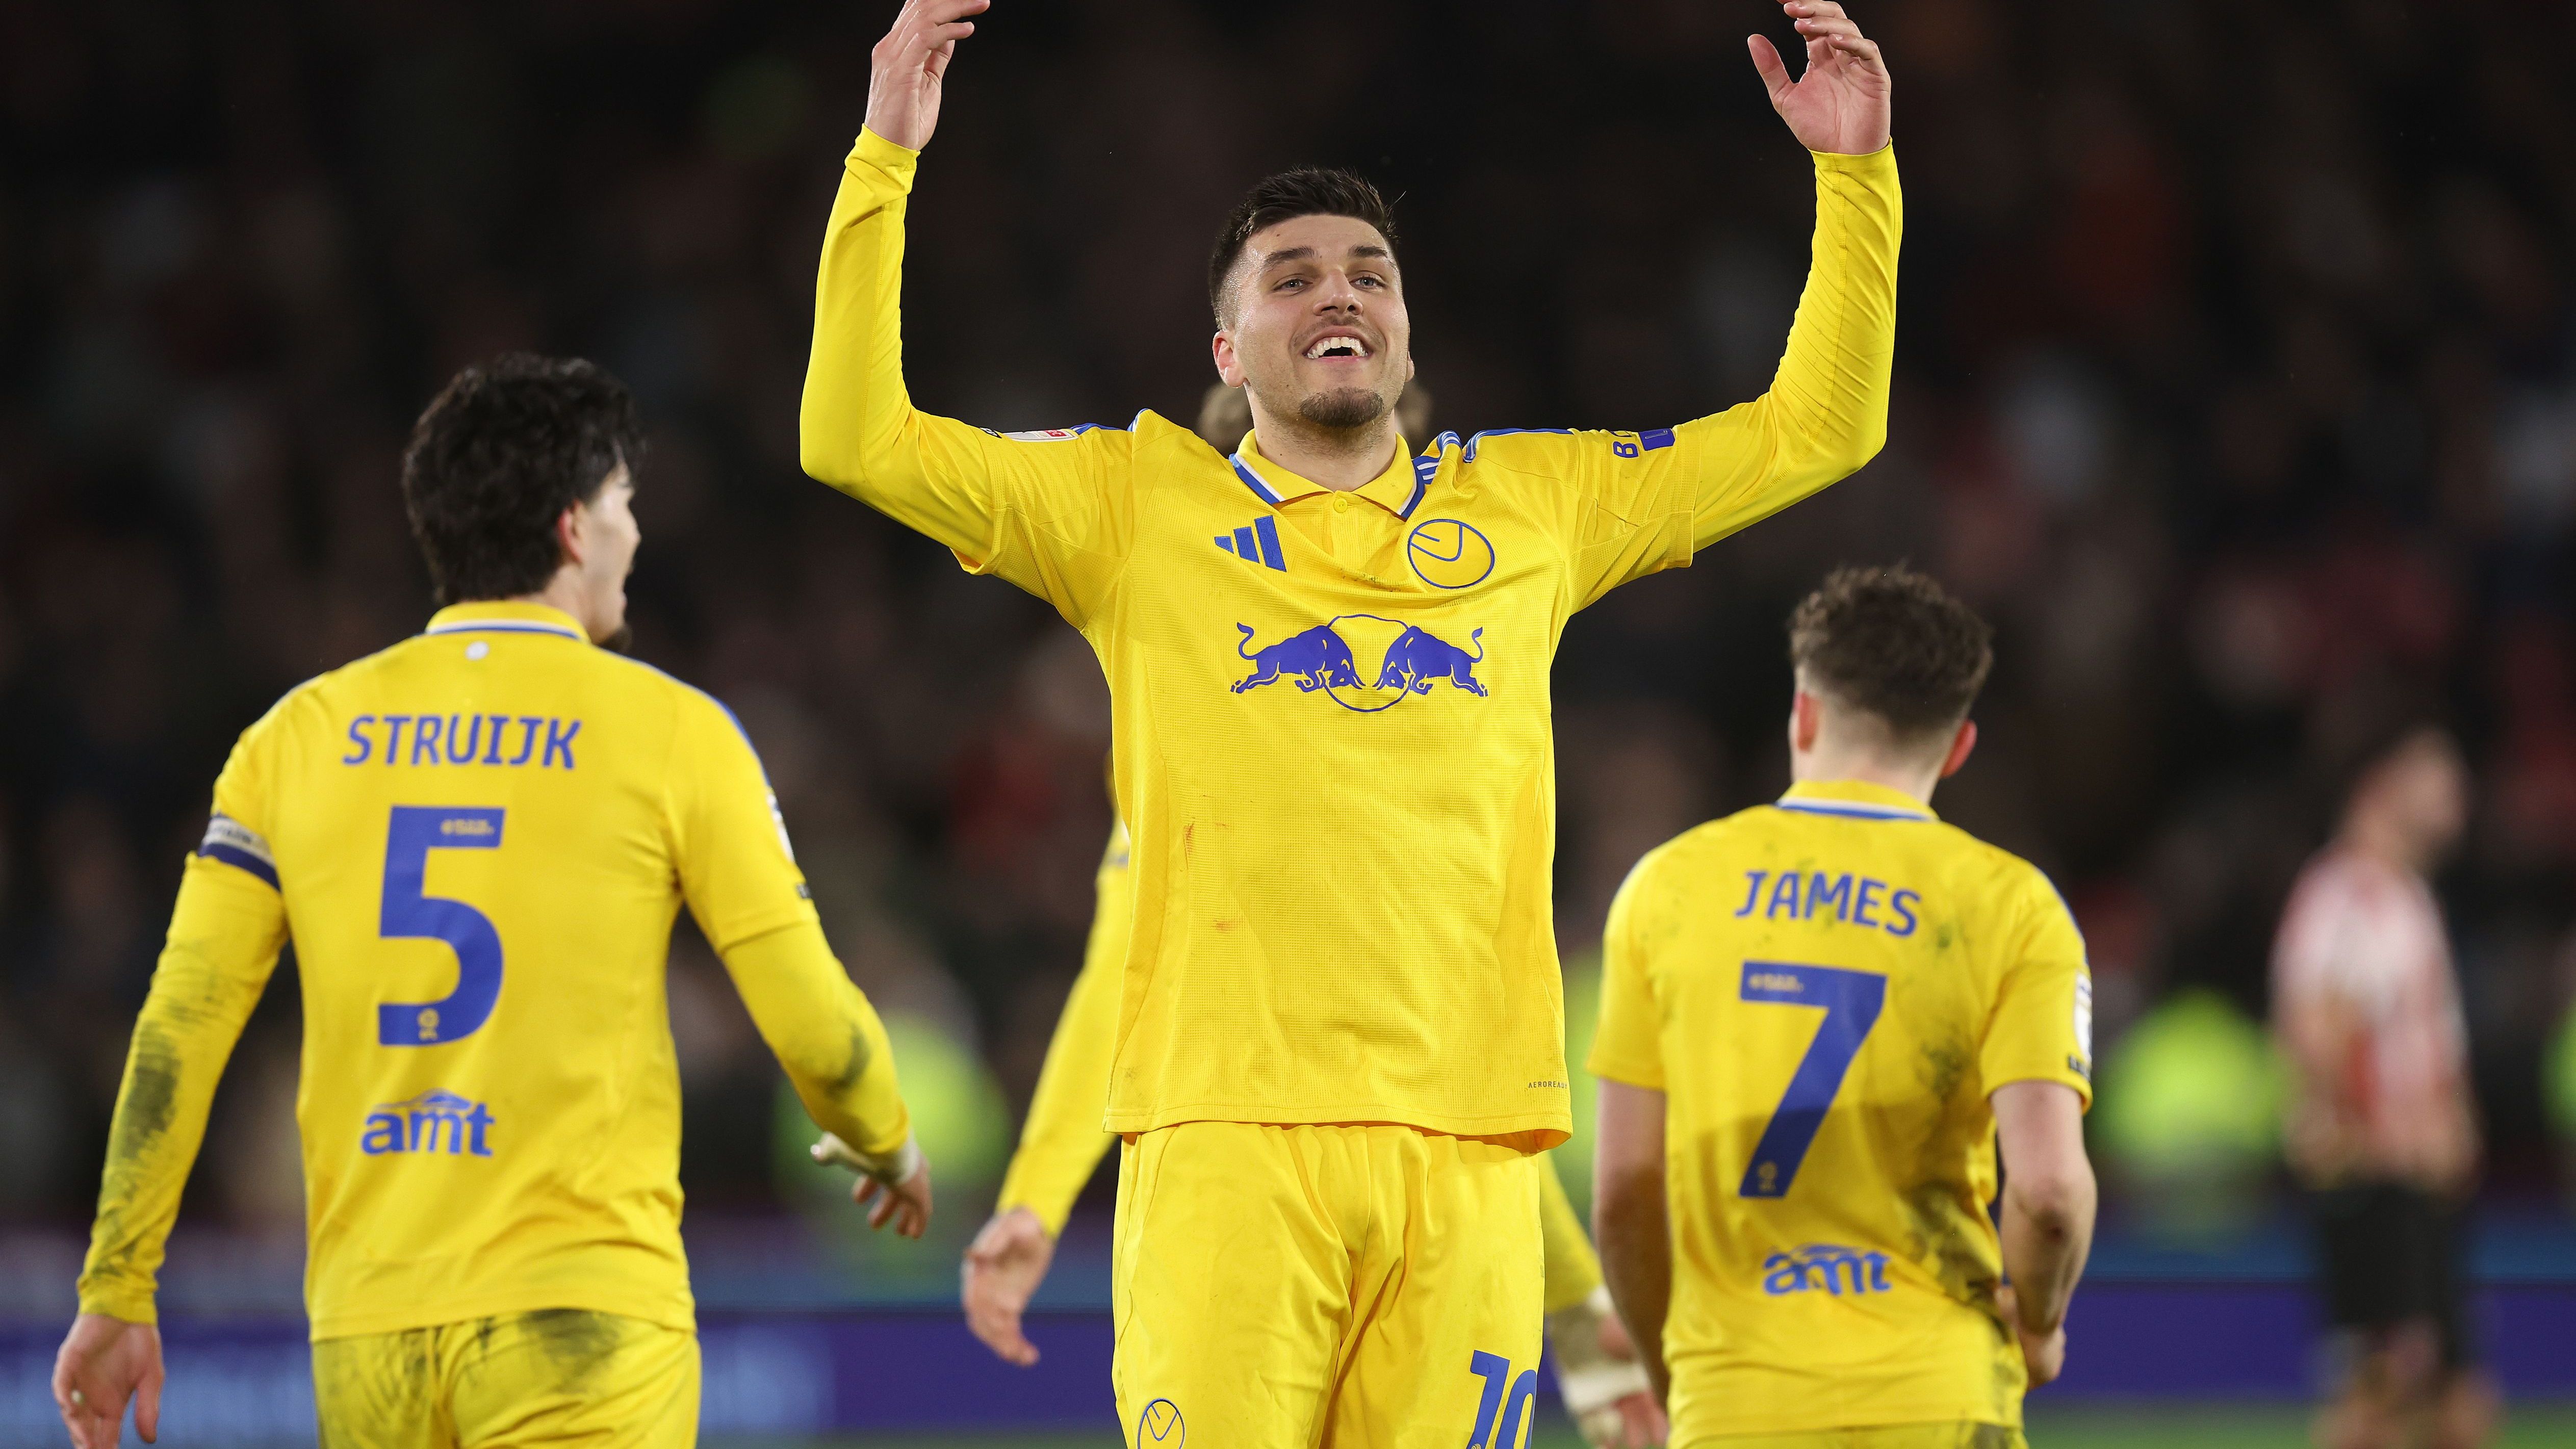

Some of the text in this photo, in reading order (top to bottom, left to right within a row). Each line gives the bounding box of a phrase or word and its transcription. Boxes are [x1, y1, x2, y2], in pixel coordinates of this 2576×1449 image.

[342, 714, 581, 770] STRUIJK
[378, 805, 506, 1047] 5
[1735, 871, 1920, 937] JAMES
[1739, 961, 1888, 1198] 7
[360, 1100, 495, 1157] amt
[1763, 1249, 1891, 1296] amt
[1466, 1350, 1537, 1449] 10
